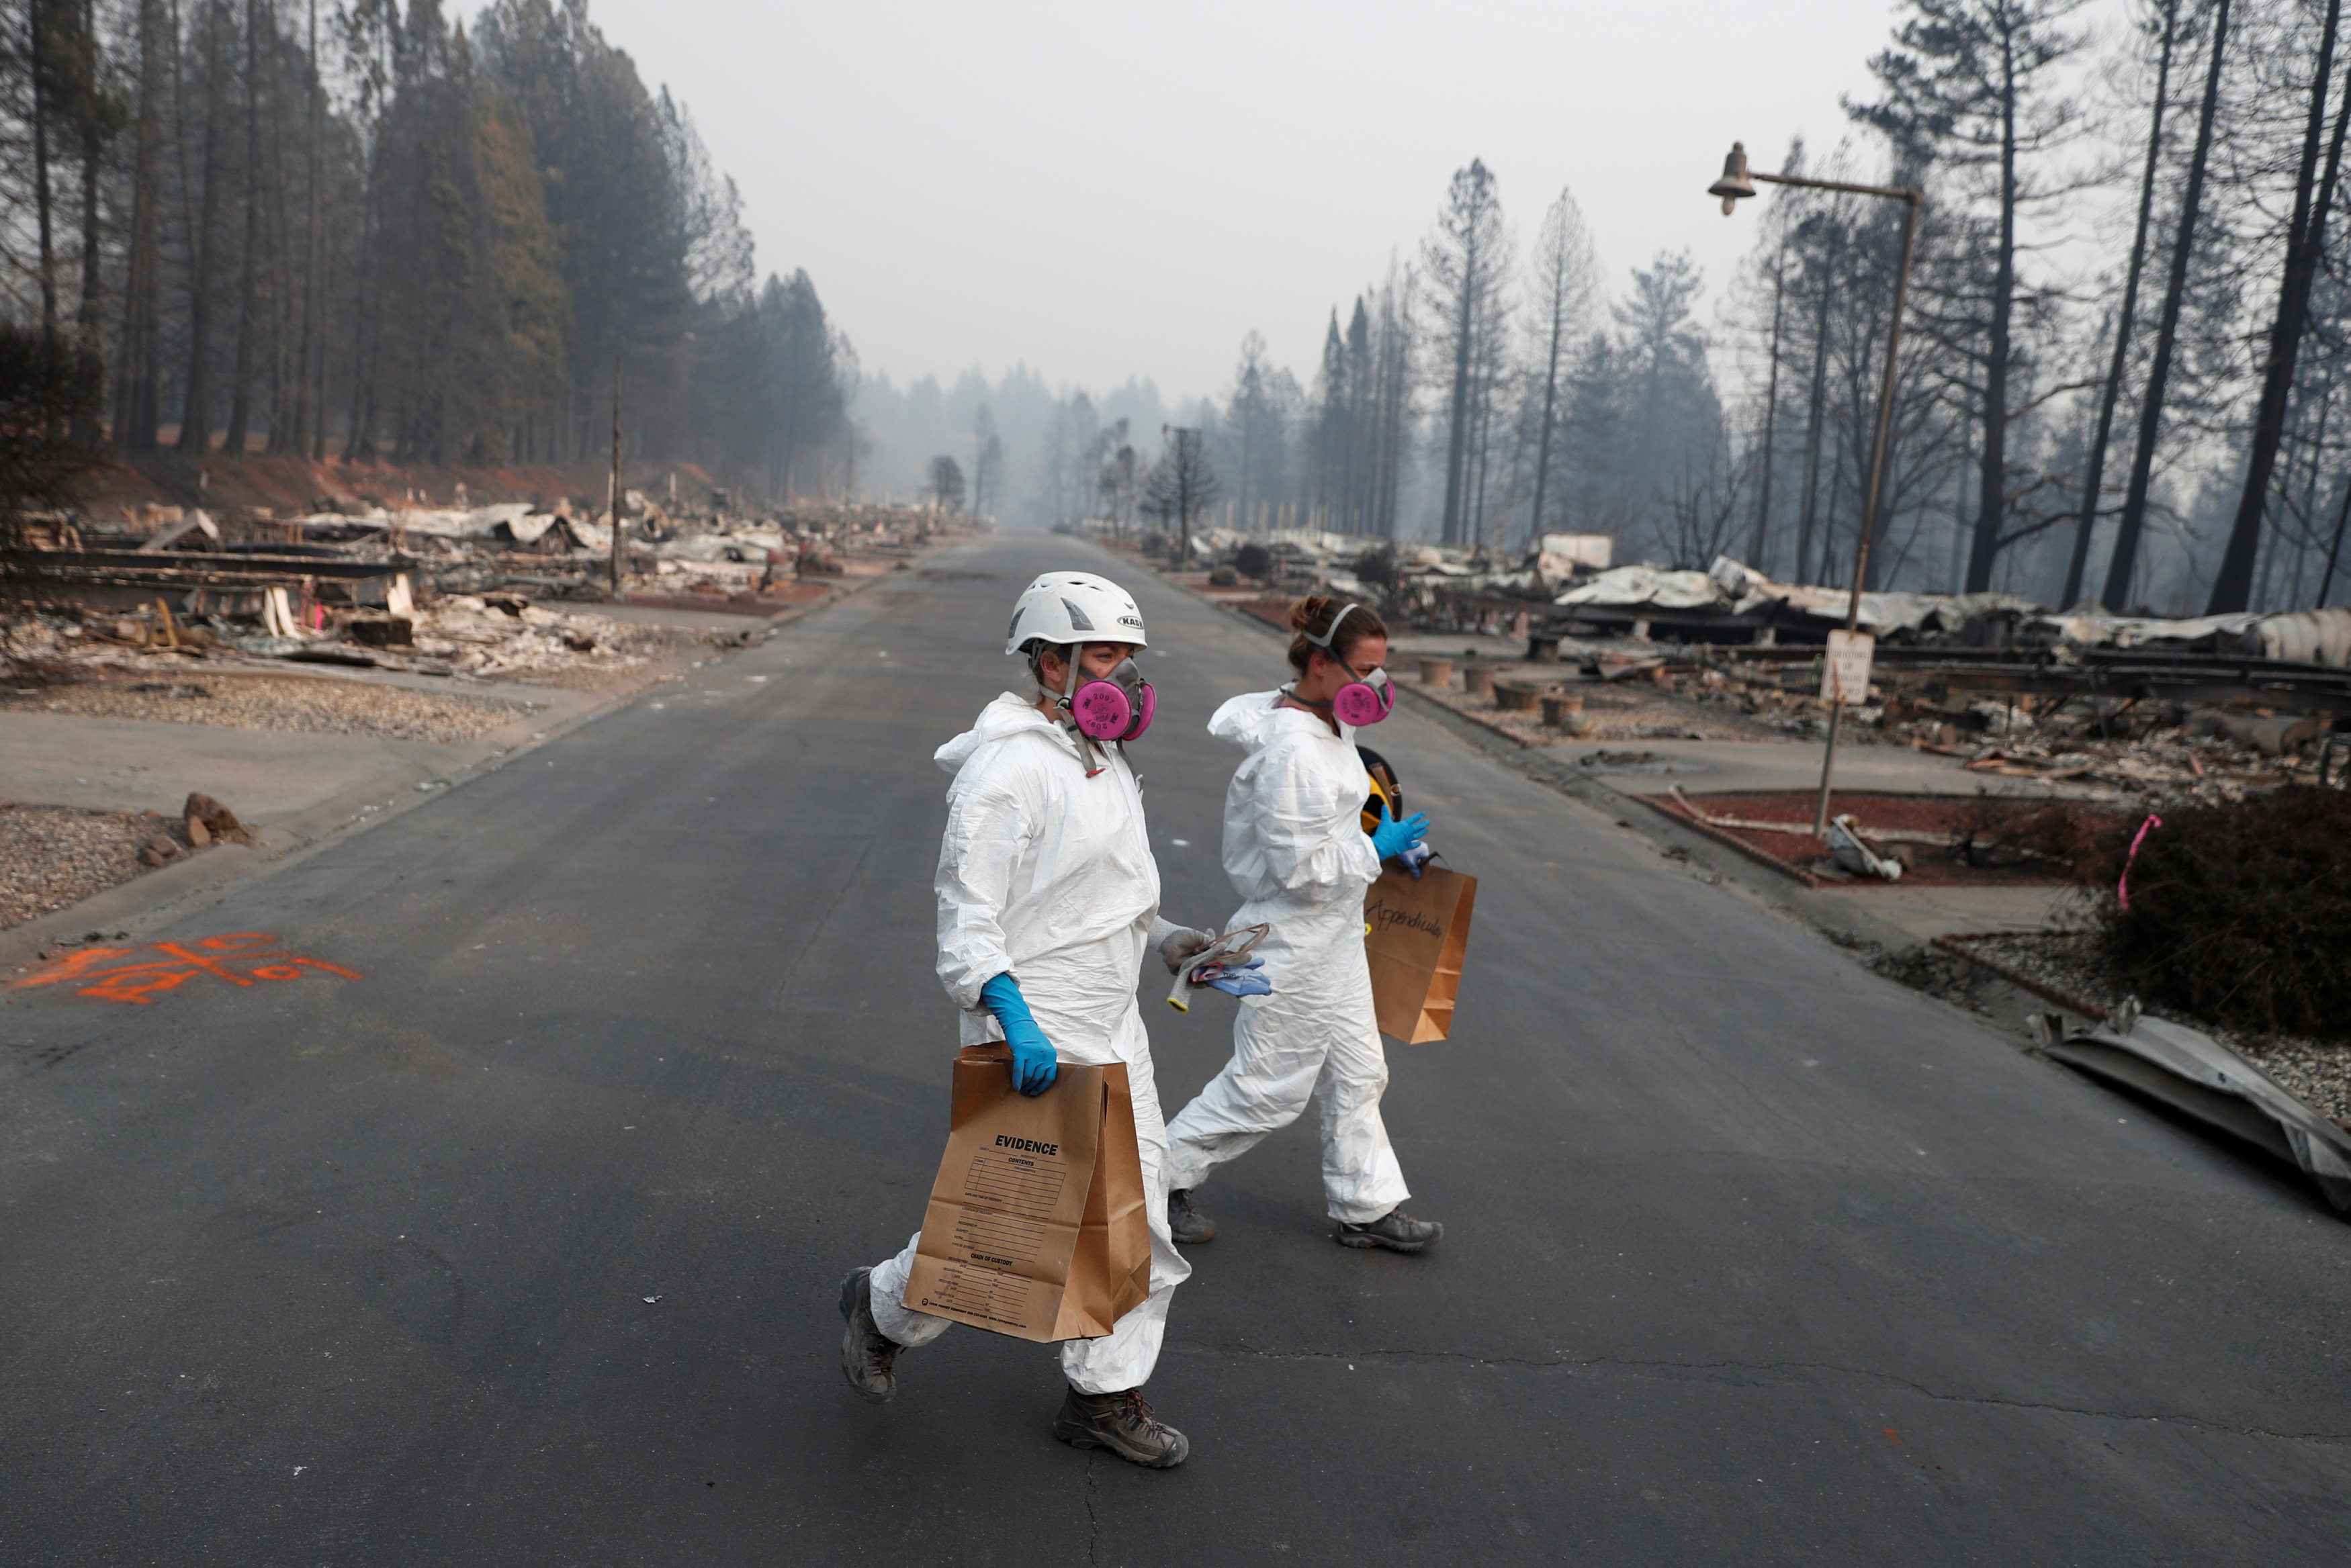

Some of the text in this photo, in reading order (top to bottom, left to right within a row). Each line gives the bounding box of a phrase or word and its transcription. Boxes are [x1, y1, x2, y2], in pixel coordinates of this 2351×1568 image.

[1082, 697, 1092, 709] 3M
[1094, 693, 1115, 704] 2097
[1086, 719, 1107, 729] 2097
[995, 1135, 1059, 1156] EVIDENCE
[1008, 1158, 1034, 1166] CONTENTS
[991, 1257, 1013, 1266] CUSTODY
